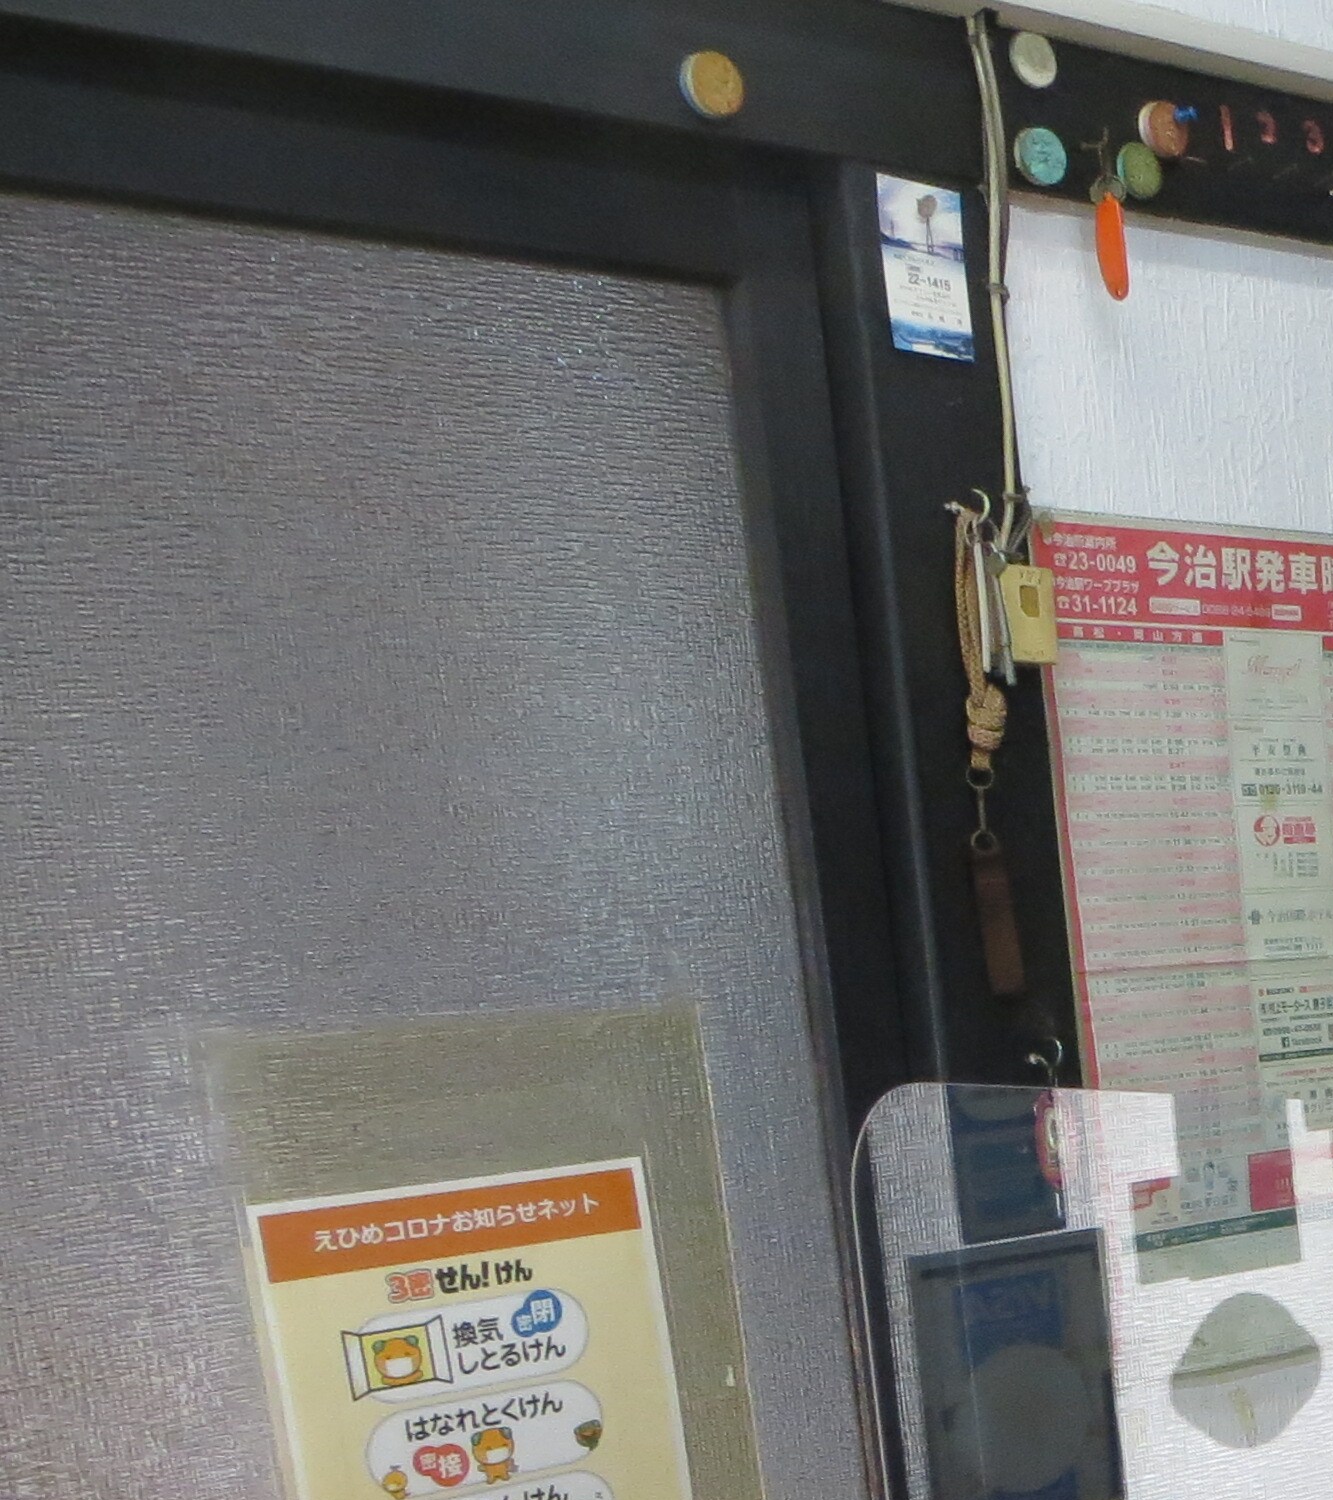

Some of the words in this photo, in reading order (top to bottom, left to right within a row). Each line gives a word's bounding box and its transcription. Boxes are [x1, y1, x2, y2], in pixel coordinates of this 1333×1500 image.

[1067, 551, 1138, 574] 23-0049
[1071, 595, 1138, 616] 31-1124
[313, 1191, 600, 1253] えひめコロナお知らせネット
[452, 1317, 505, 1349] 換気
[458, 1336, 567, 1376] しとるけん
[404, 1392, 564, 1442] はなれとくけん
